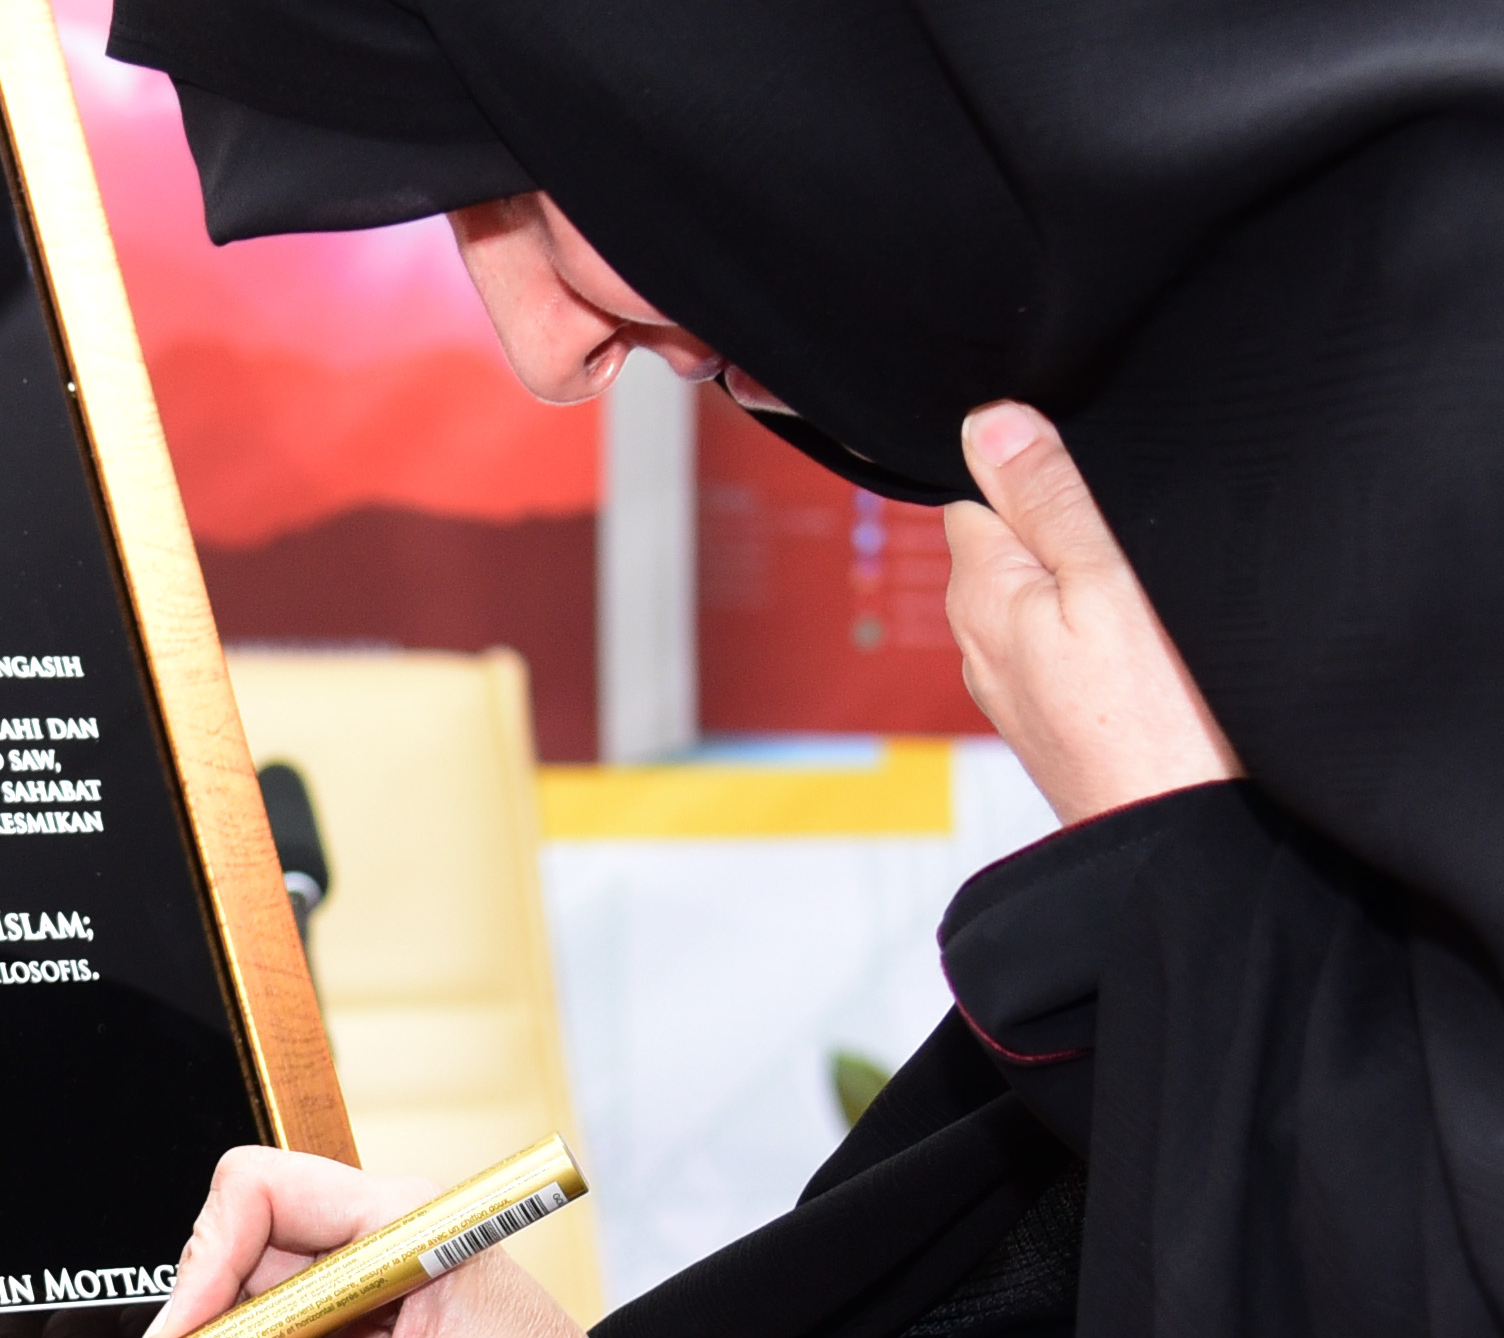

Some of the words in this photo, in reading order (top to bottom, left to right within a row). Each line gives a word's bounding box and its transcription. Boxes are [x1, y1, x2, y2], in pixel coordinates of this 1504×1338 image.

[46, 718, 99, 739] DAN
[8, 749, 61, 773] SAW,
[1, 780, 101, 803] SAHABAT
[44, 1264, 180, 1302] MOTTAG
